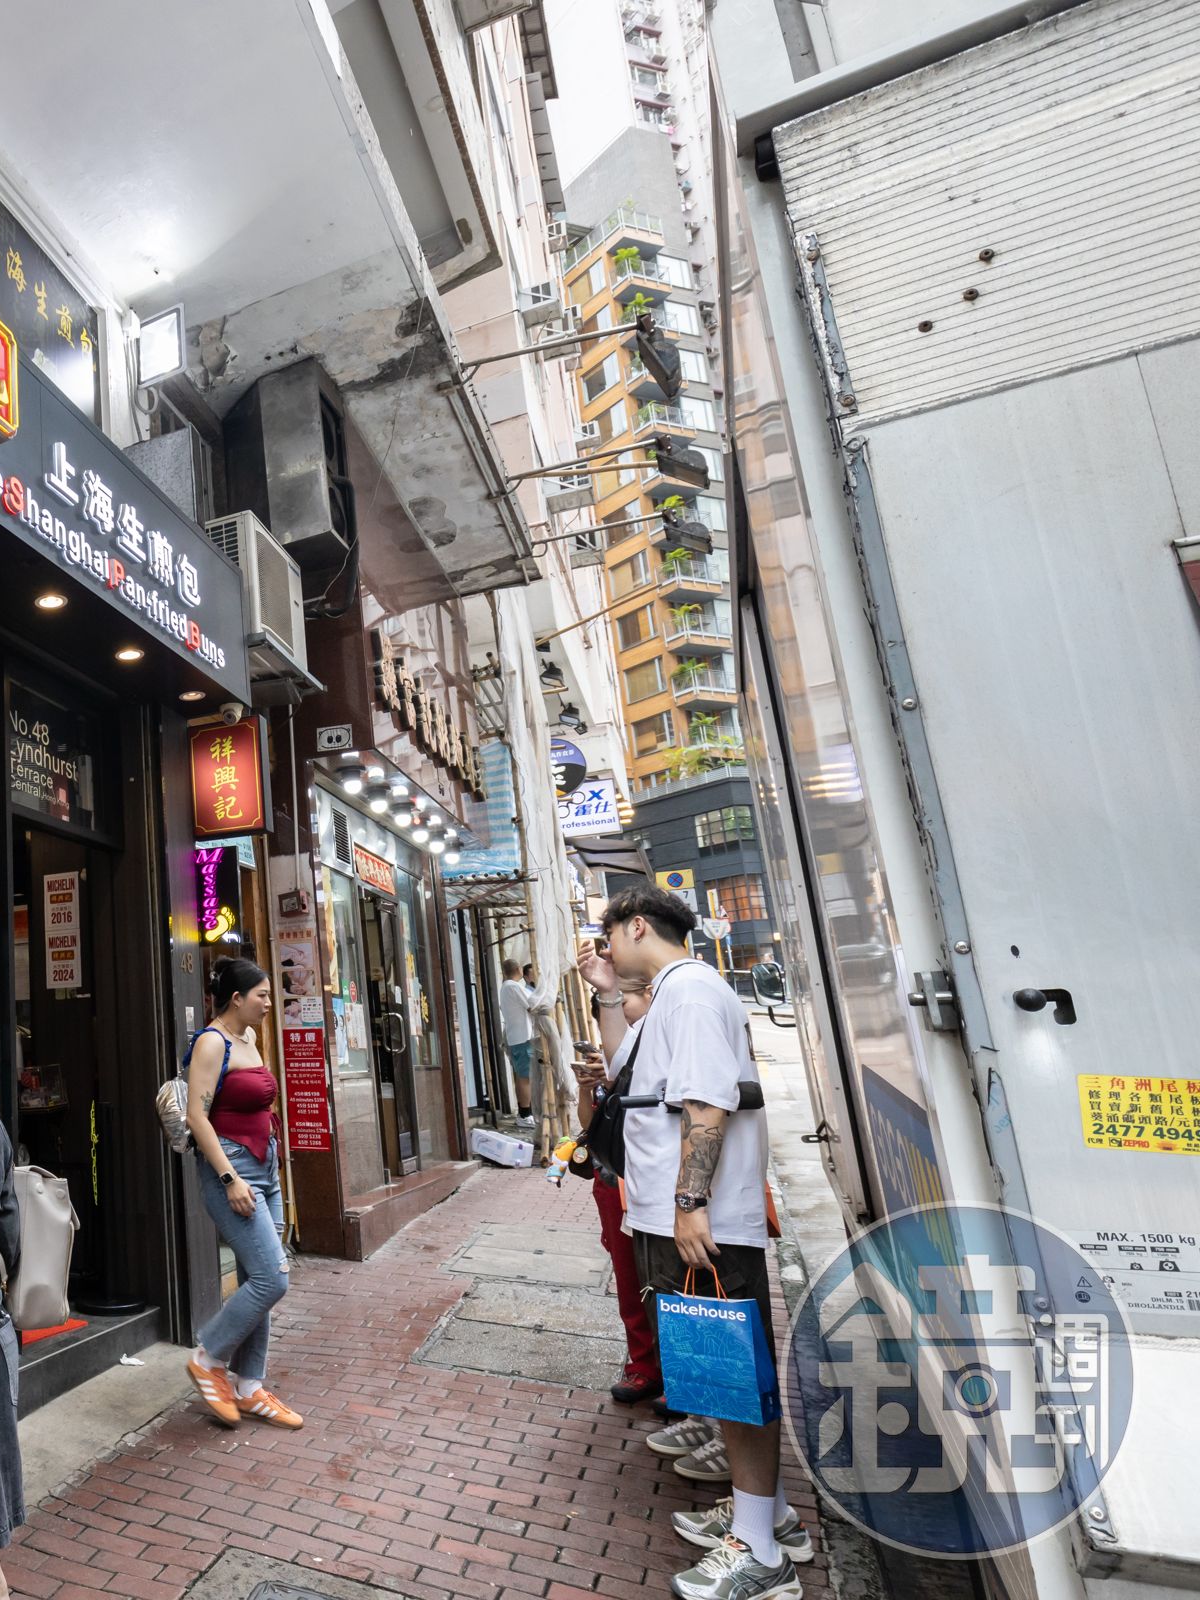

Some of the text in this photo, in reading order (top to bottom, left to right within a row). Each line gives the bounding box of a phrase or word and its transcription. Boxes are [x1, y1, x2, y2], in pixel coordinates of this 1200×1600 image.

[44, 441, 201, 608] 上海生煎包
[2, 476, 109, 583] Shanghai
[186, 620, 226, 669] Buns
[10, 740, 78, 782] yndhurst
[209, 735, 244, 821] 祥興記
[561, 816, 616, 829] rofessional
[47, 878, 75, 892] MICHELIN
[196, 848, 224, 930] Massage
[51, 911, 73, 924] 2016
[48, 935, 77, 949] MICHELIN
[180, 953, 194, 974] 48
[53, 969, 74, 982] 2024
[290, 1032, 316, 1042] 特價
[1092, 1122, 1145, 1138] 2477
[1123, 1139, 1150, 1149] ZEPRO
[1096, 1231, 1196, 1246] MAX. 1500 kg
[660, 1299, 747, 1322] bakehouse
[1127, 1302, 1186, 1311] DHOLLANDIA
